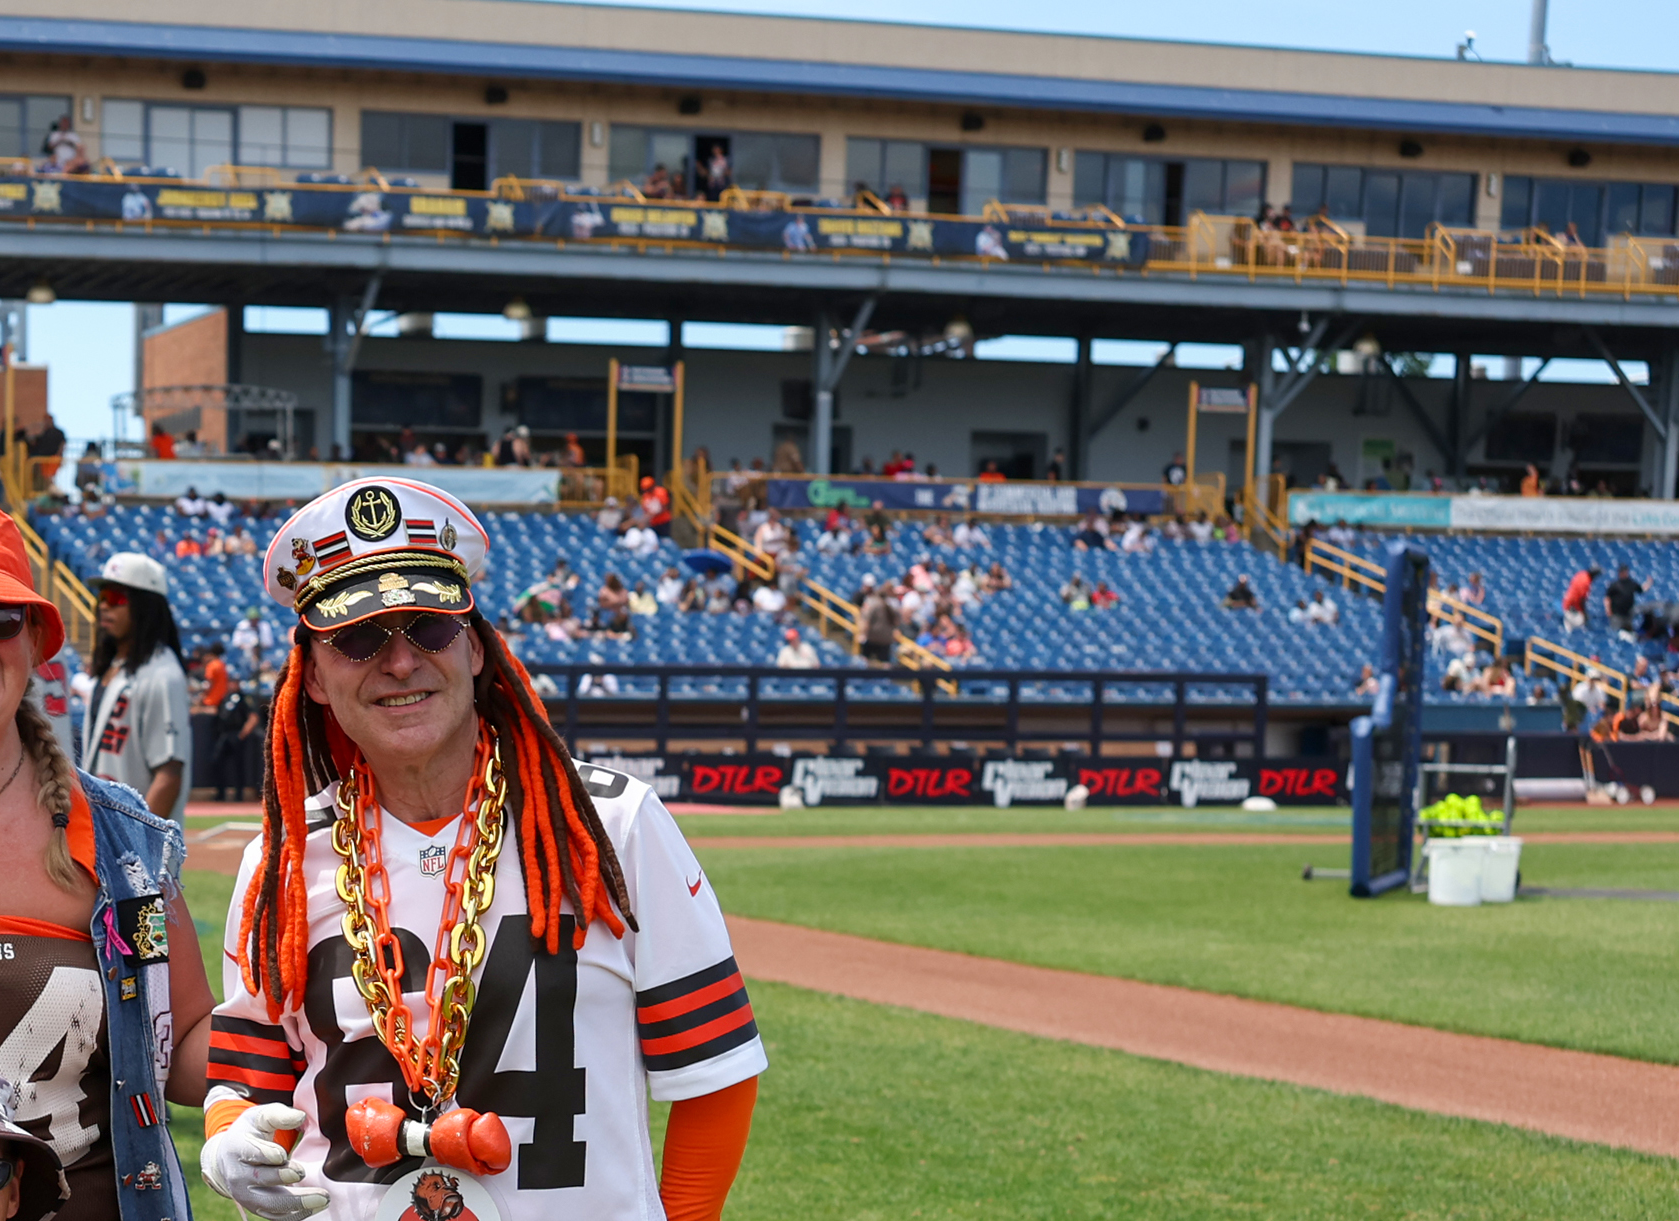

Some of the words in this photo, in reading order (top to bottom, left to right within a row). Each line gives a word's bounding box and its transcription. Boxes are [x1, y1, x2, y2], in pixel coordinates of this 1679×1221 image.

[692, 764, 783, 794] DTLR
[887, 767, 972, 797] DTLR
[1079, 767, 1162, 797] DTLR
[1258, 767, 1337, 797] DTLR
[422, 857, 444, 871] NFL
[306, 914, 587, 1190] 84
